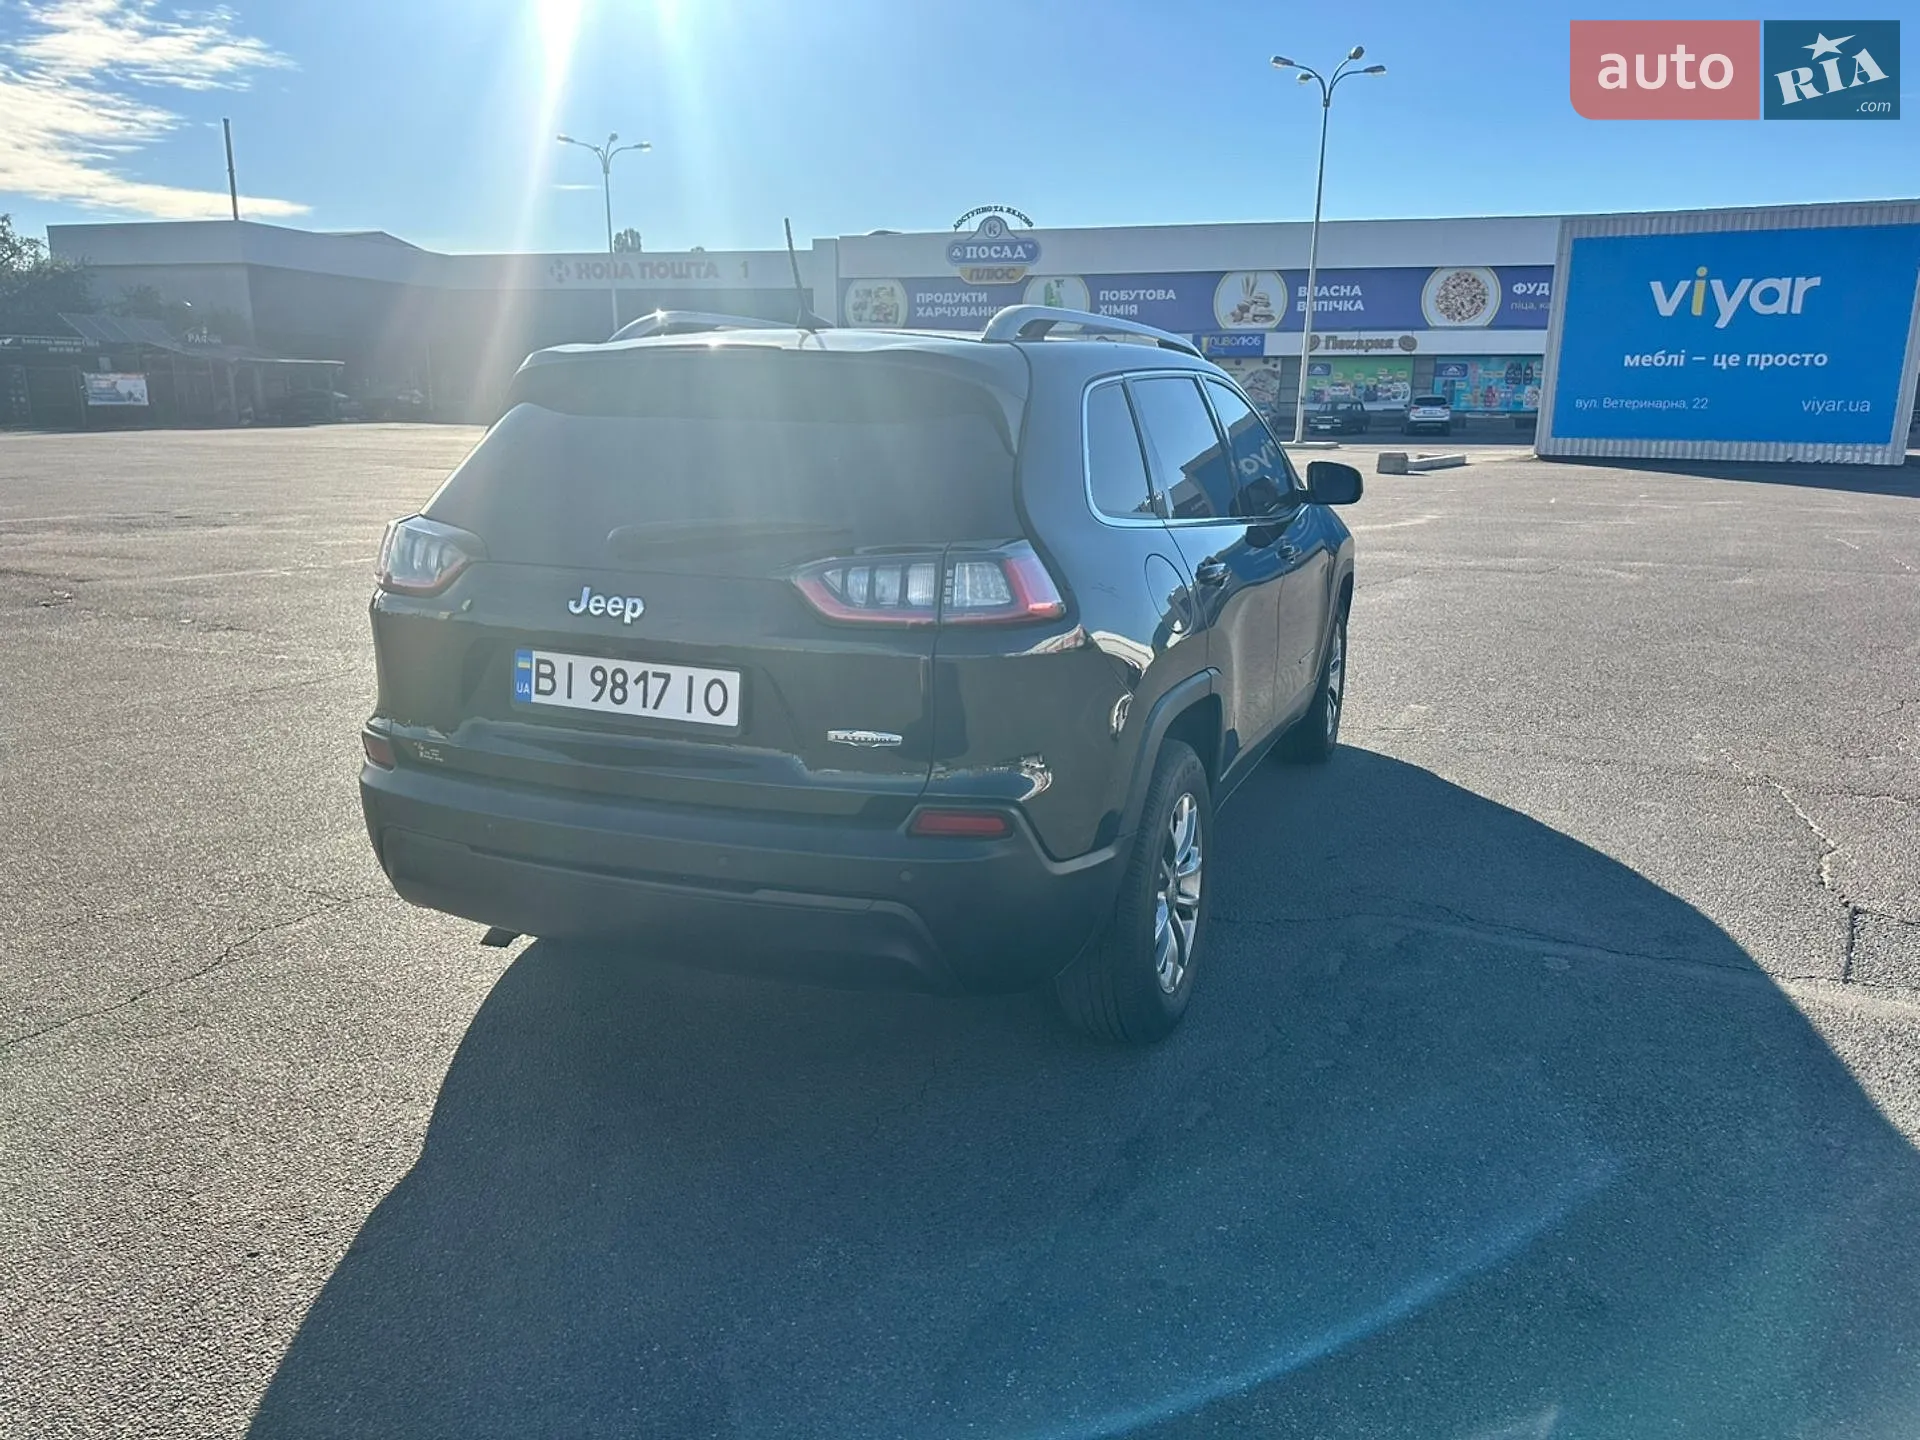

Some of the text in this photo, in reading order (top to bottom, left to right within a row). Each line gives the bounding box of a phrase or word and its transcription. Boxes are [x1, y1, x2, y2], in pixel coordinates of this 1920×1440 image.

[965, 244, 1027, 259] ПОСАД
[637, 261, 721, 280] ПОШТА
[739, 261, 749, 279] 1
[969, 267, 1017, 280] ПЛЮС
[1099, 289, 1177, 301] ПОБУТОВА
[1512, 282, 1550, 296] ФУД
[916, 292, 988, 305] ПРОДУКТИ
[1649, 266, 1822, 330] viyar
[1099, 303, 1138, 316] ХІМІЯ
[1624, 350, 1686, 368] меблі
[1713, 354, 1740, 370] це
[1746, 353, 1829, 371] просто
[1692, 397, 1709, 410] 22
[1801, 397, 1872, 416] viyar.ua
[567, 586, 646, 625] Jeep
[516, 680, 531, 695] UA
[534, 657, 729, 718] BI 9817 IO
